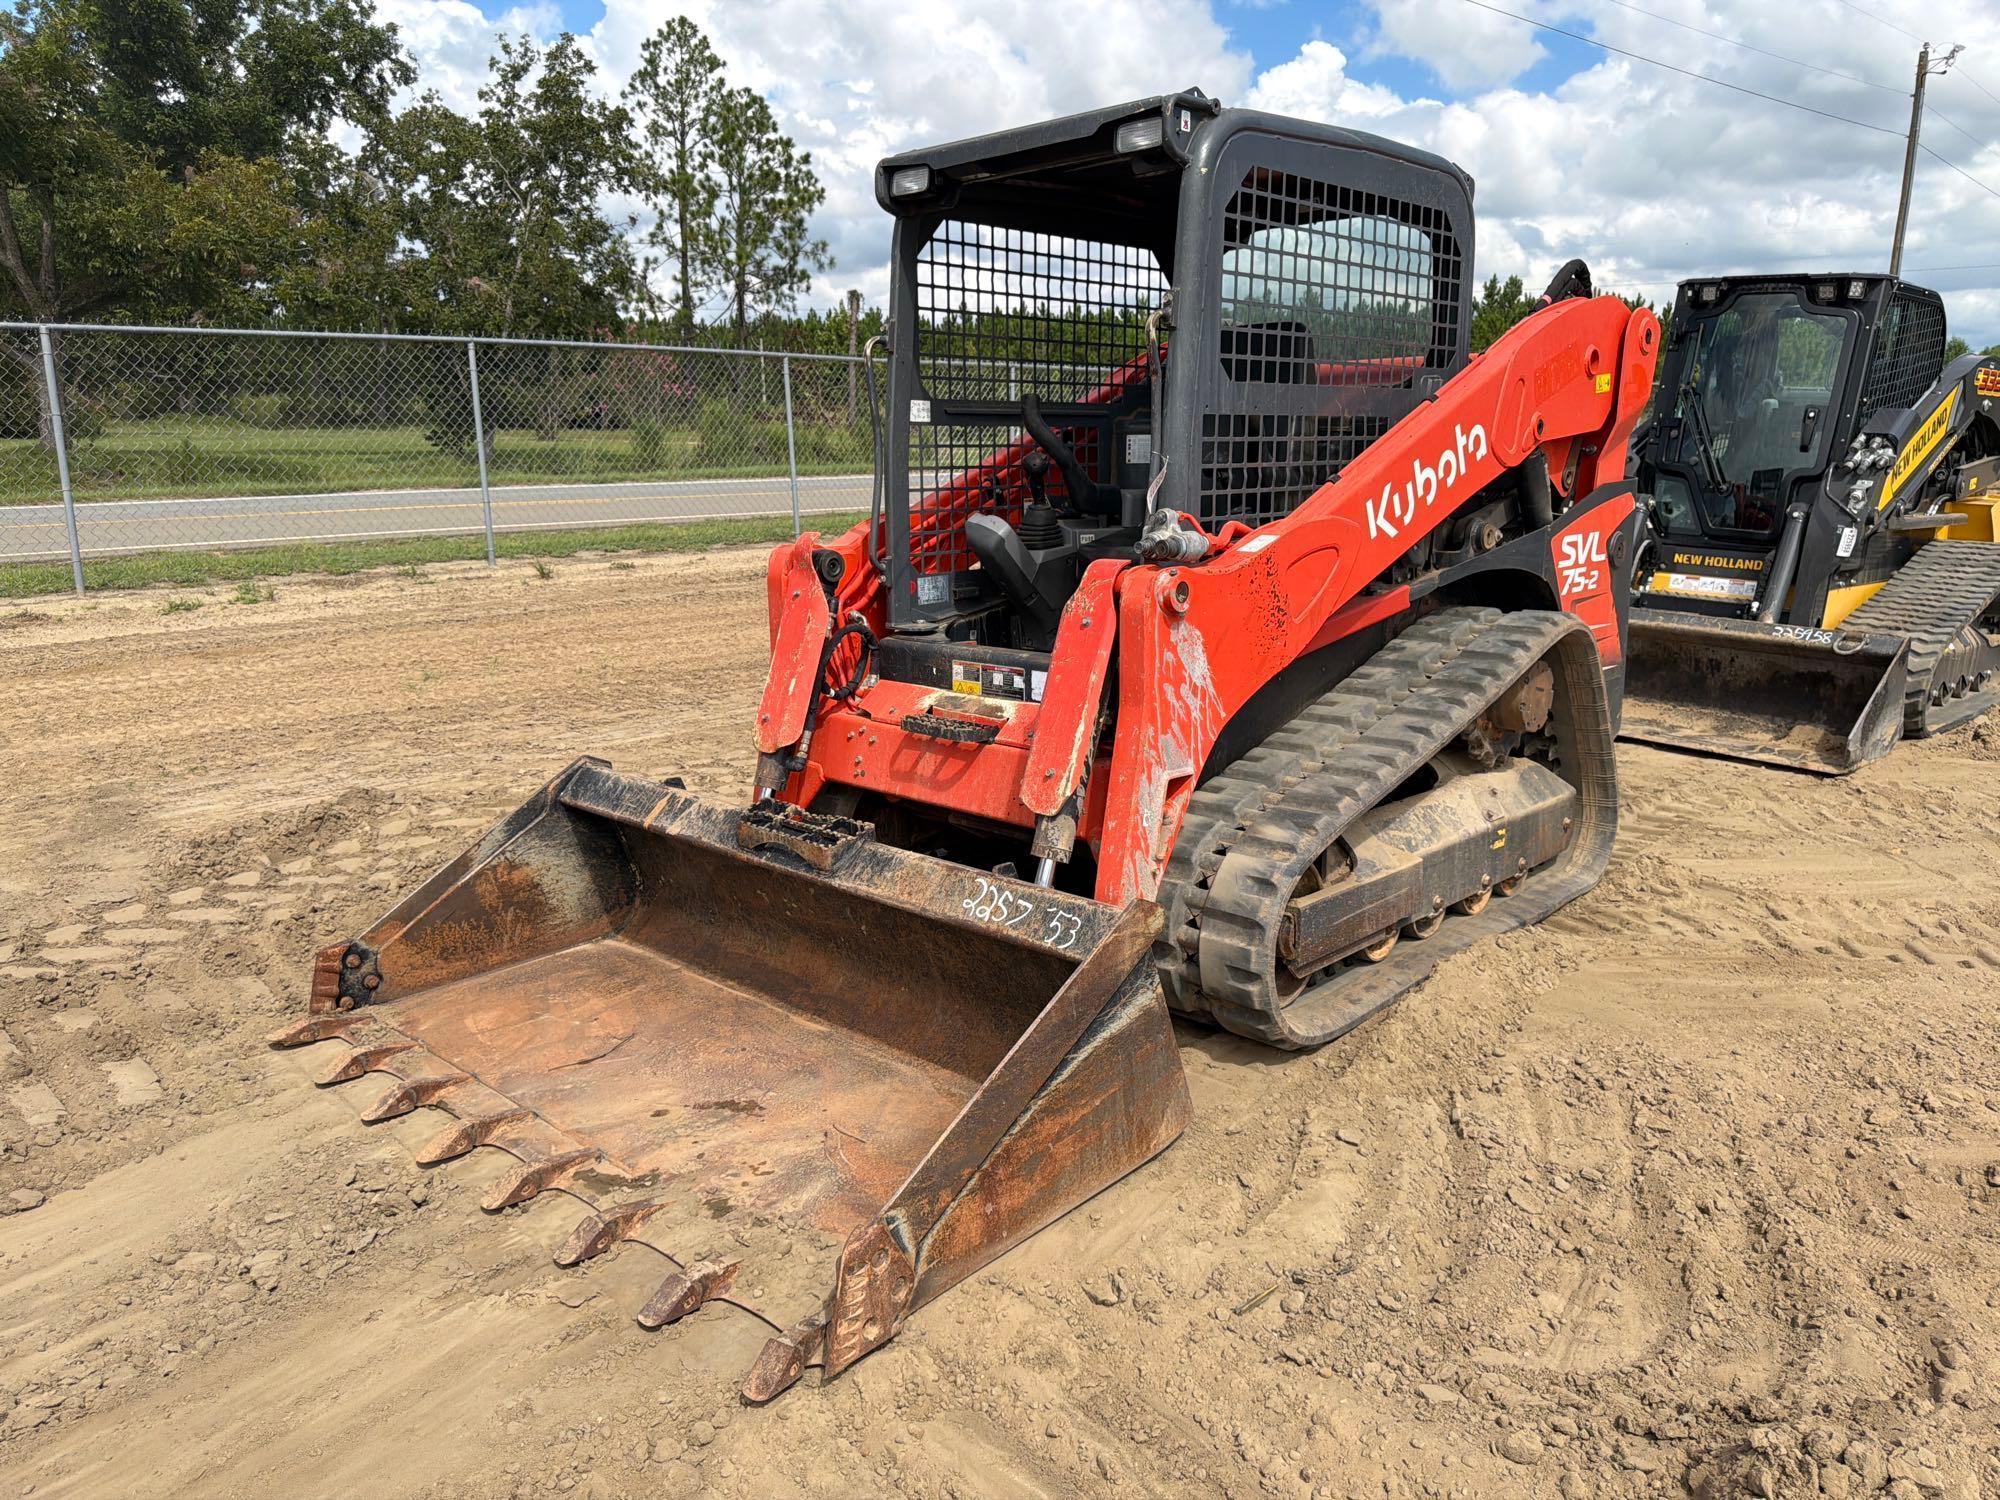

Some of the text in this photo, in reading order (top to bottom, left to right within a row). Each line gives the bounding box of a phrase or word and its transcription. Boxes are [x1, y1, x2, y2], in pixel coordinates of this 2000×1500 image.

[1891, 449, 1911, 480] NEW
[1912, 407, 1948, 460] HOLLAND
[1366, 423, 1488, 540] Kubota
[1558, 531, 1606, 569] SVL
[1673, 553, 1764, 571] NEW HOLLAND
[1561, 566, 1600, 597] 75-2
